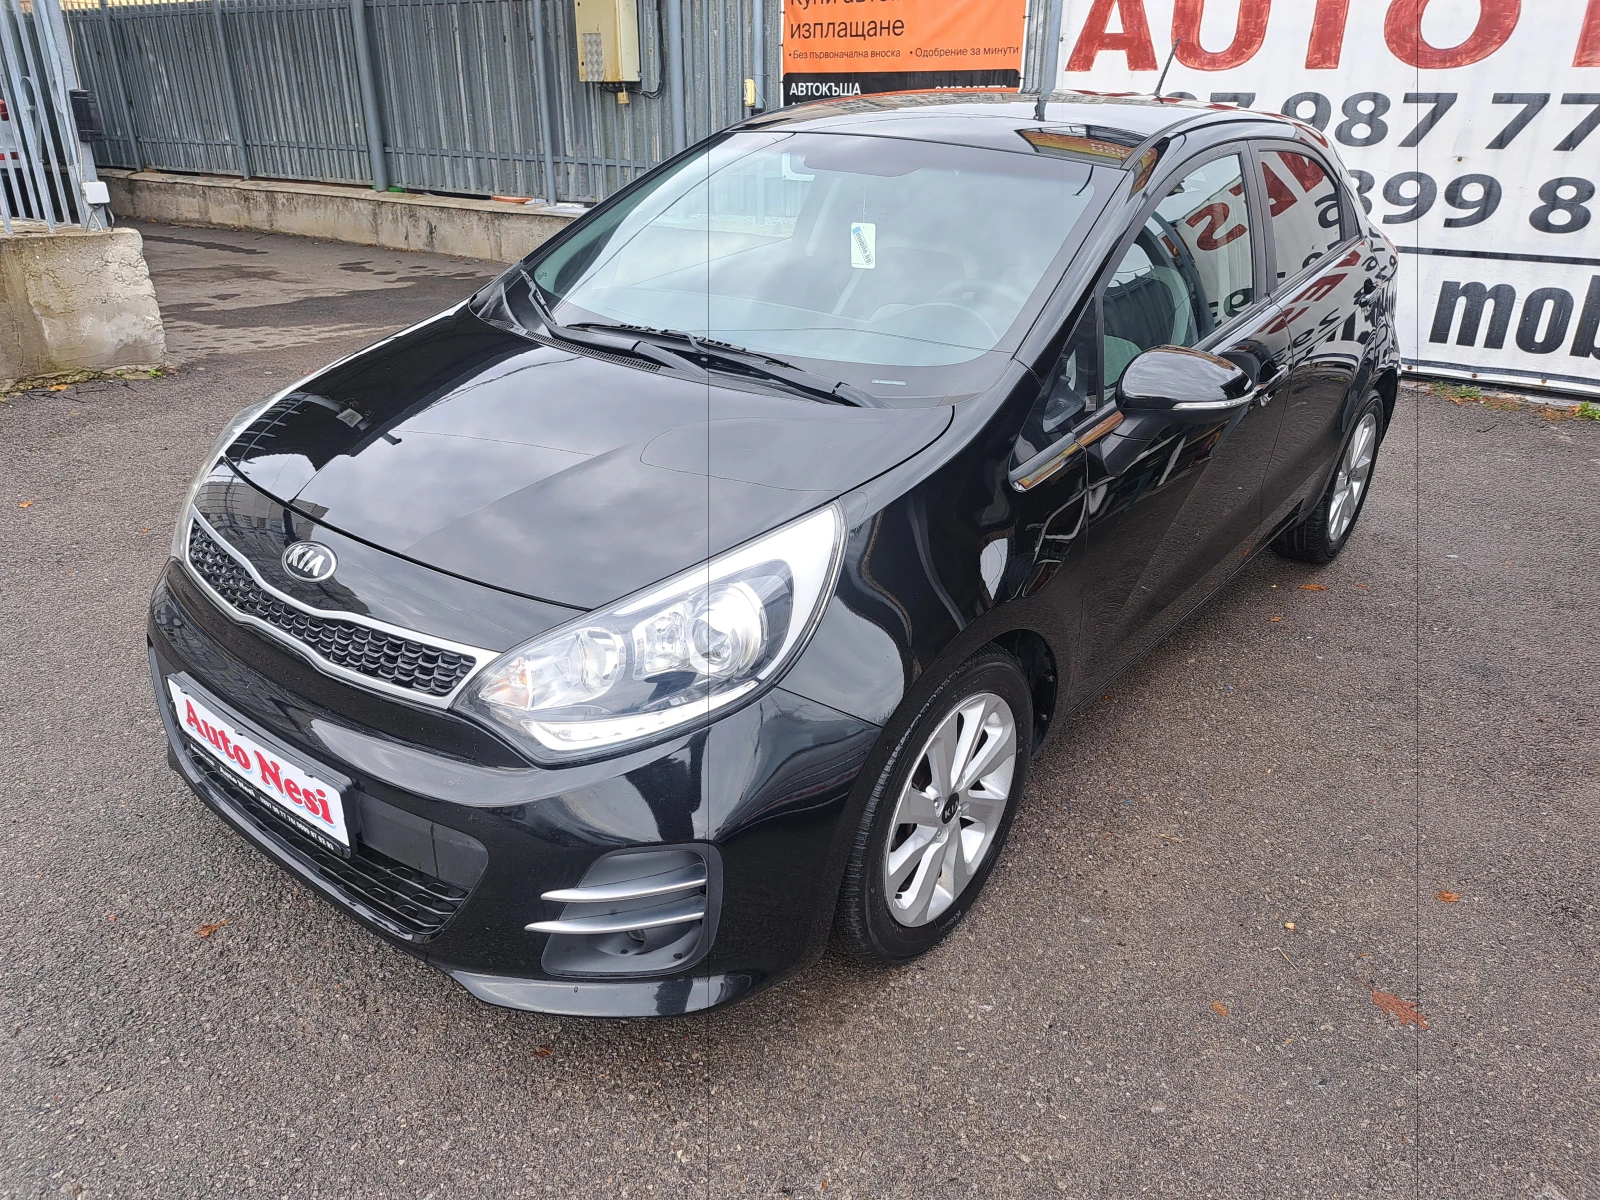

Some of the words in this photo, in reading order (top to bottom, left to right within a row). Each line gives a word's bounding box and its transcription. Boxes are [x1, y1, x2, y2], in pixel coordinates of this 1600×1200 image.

[790, 19, 904, 41] изплащане
[793, 50, 808, 60] Без
[810, 50, 868, 61] първоначална
[871, 49, 901, 58] вноска
[915, 47, 968, 59] Одобрение
[970, 47, 981, 56] за
[983, 46, 1019, 57] минути
[1281, 91, 1458, 147] 987
[1484, 93, 1600, 151] 77
[1529, 177, 1595, 233] 8
[286, 545, 326, 577] KIA
[185, 698, 252, 771] Auto
[253, 749, 335, 825] Nesi
